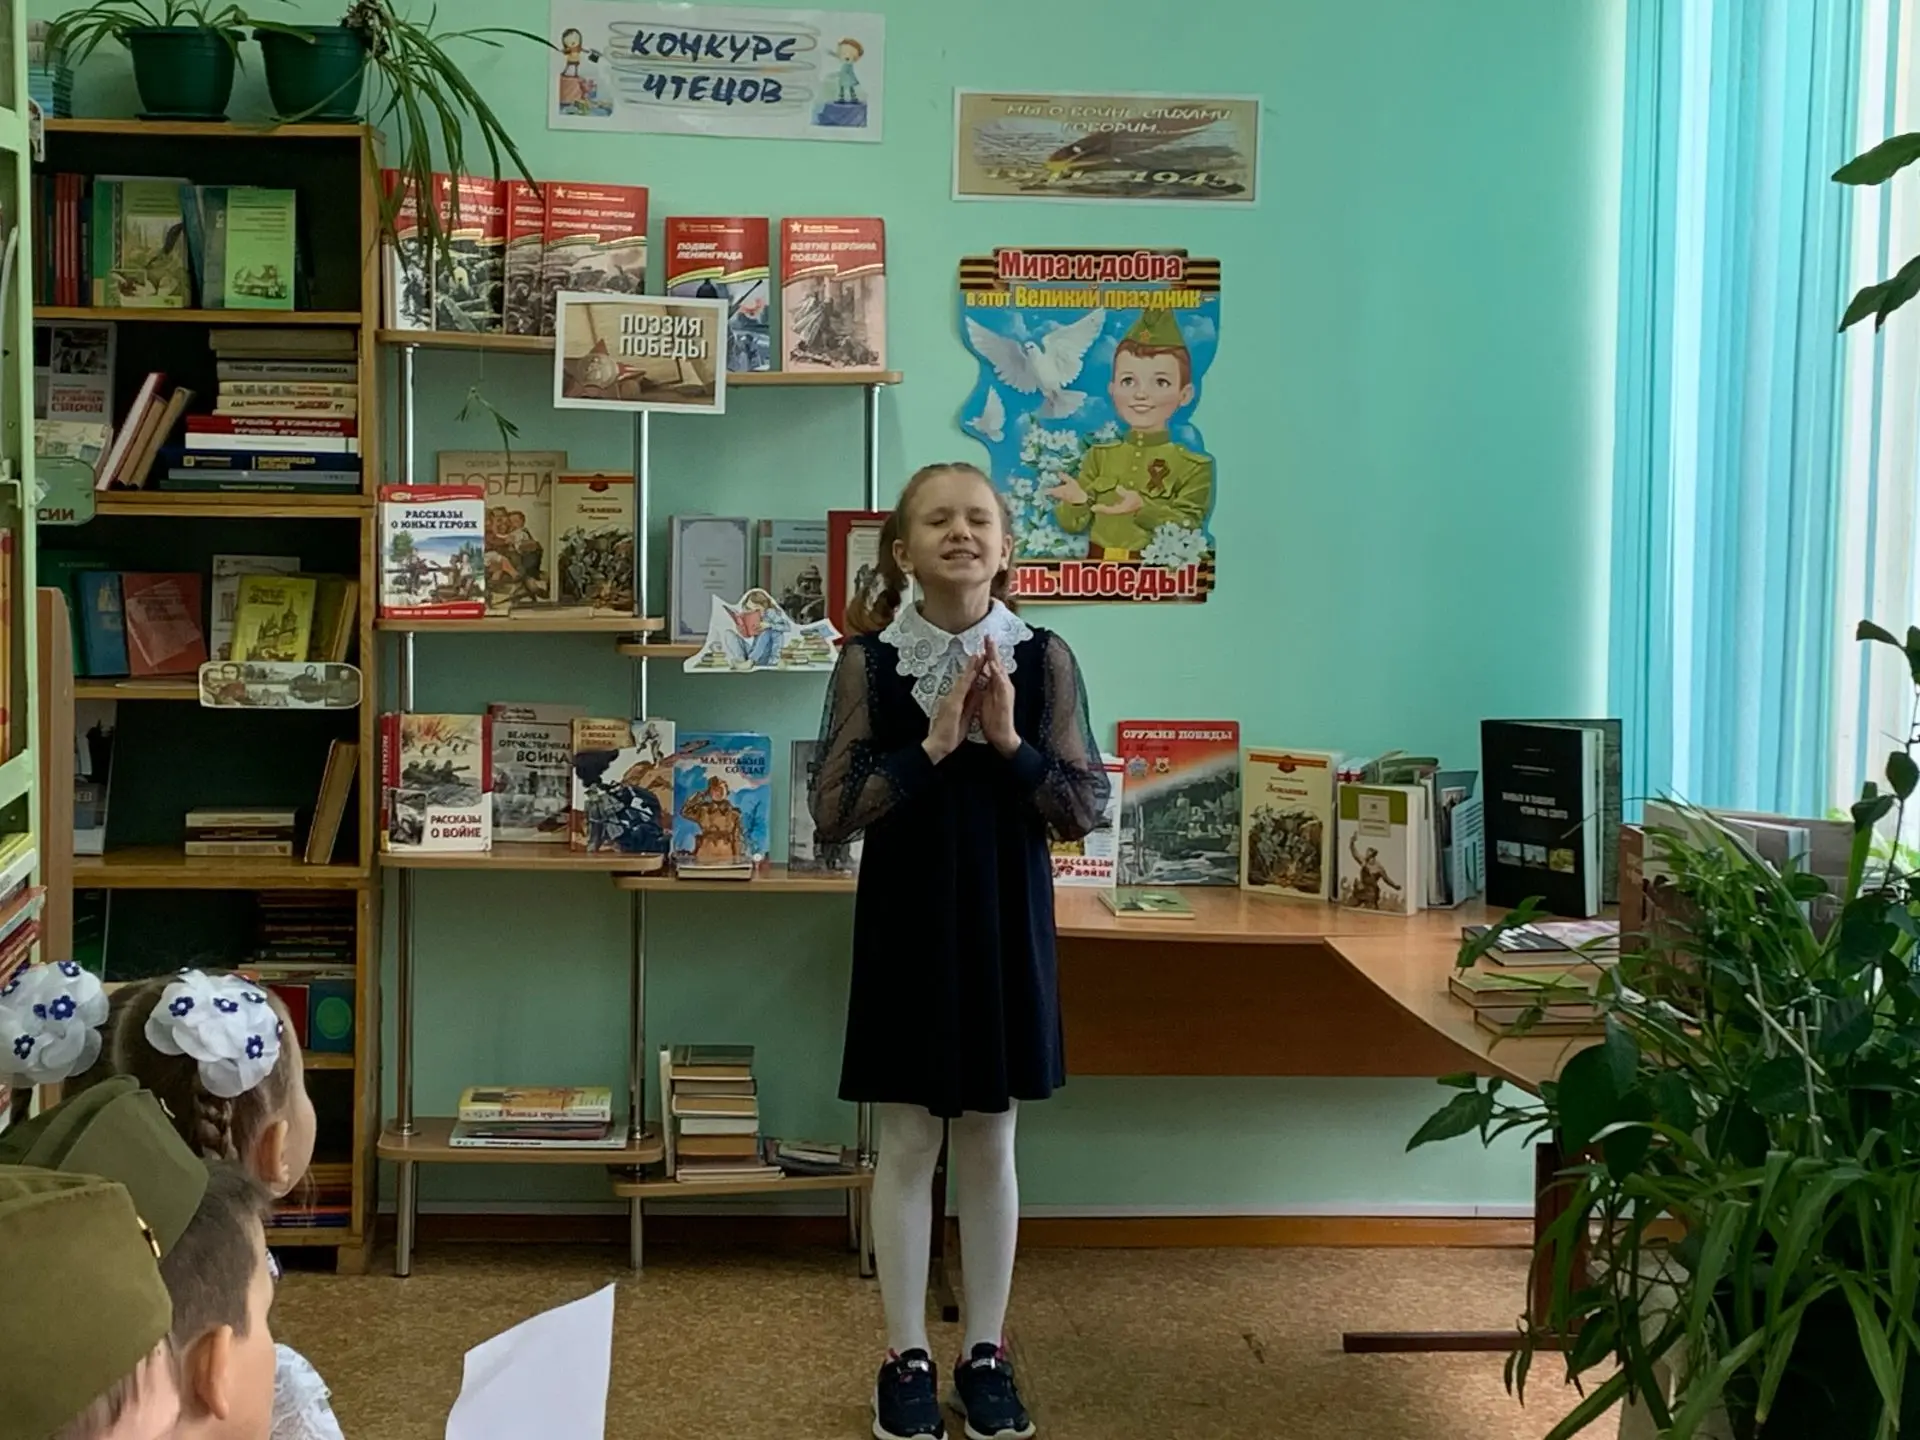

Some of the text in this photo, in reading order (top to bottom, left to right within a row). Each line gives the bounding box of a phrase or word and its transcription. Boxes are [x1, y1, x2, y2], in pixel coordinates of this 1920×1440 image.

[631, 29, 797, 63] КОНКУРС
[643, 73, 783, 106] ЧТЕЦОВ
[676, 242, 719, 251] ПОДВИГ
[831, 242, 877, 251] БЕРЛИНА
[676, 251, 743, 260] ЛЕНИНГРАДА
[1001, 251, 1183, 282] Мира и добра
[1015, 284, 1100, 308] Великий
[1103, 289, 1201, 310] праздник
[620, 314, 702, 337] ПОЭЗИЯ
[619, 335, 707, 361] ПОБЕДЫ
[37, 508, 75, 520] СИИ
[405, 510, 463, 519] РАССКАЗЫ
[391, 521, 478, 529] О ЮНЫХ ГЕРОЯХ
[1061, 563, 1197, 599] Победы!
[507, 731, 550, 740] ВЕЛИКАЯ
[1122, 730, 1233, 741] ОРУЖИЕ ПОБЕДЫ
[431, 814, 482, 824] РАССКАЗЫ
[431, 825, 482, 838] О ВОЙНЕ
